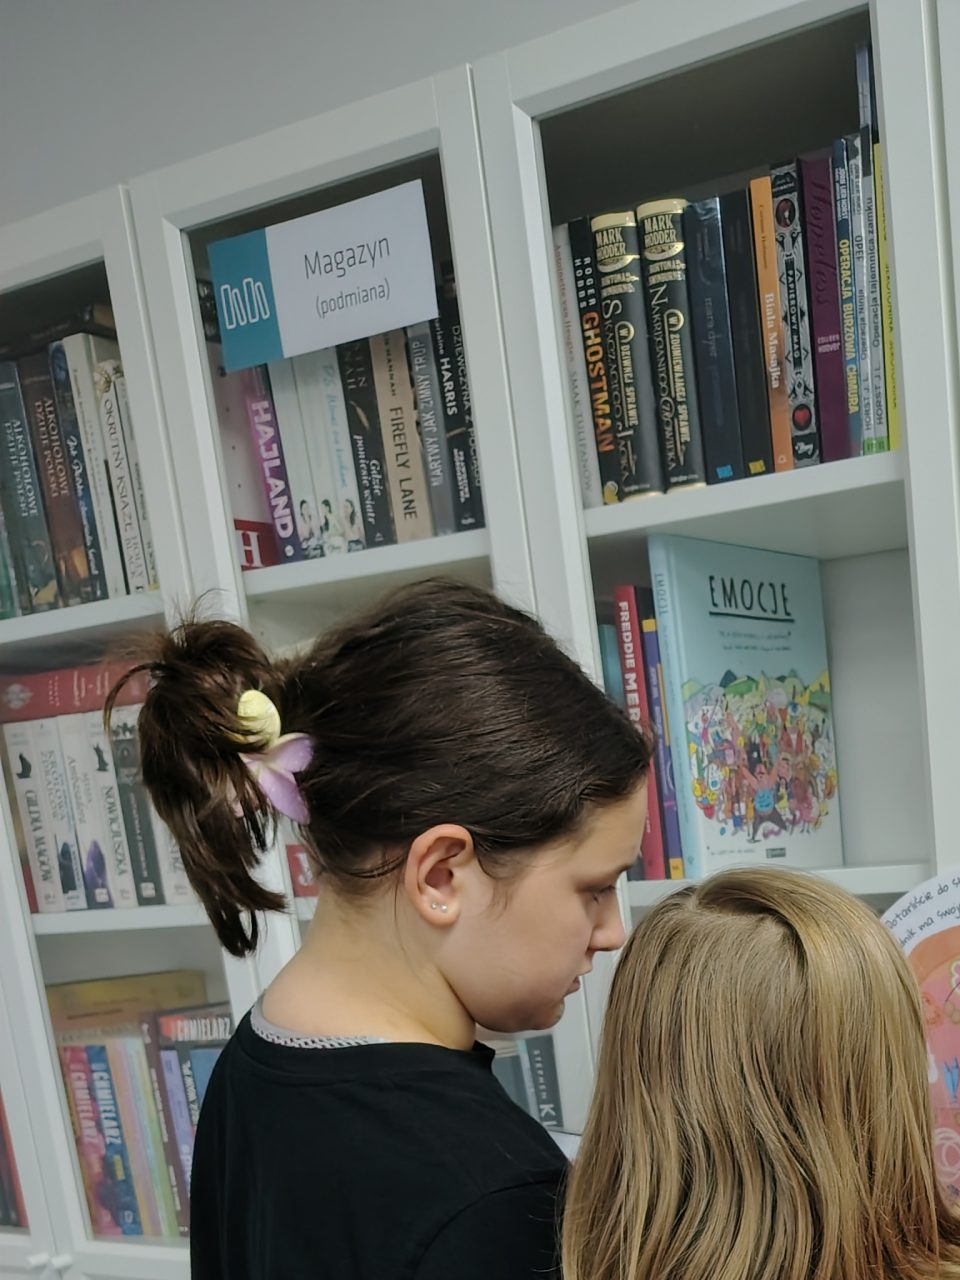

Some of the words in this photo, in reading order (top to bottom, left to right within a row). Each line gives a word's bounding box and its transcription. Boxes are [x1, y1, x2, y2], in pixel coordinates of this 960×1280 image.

[595, 227, 623, 248] MARK
[644, 214, 674, 233] MARK
[866, 196, 874, 236] zamku
[304, 237, 391, 279] Magazyn
[839, 239, 853, 299] OPERACJA
[868, 238, 878, 294] tajemnica
[315, 277, 391, 319] (podmiana)
[574, 258, 587, 309] HOBBS
[583, 257, 596, 306] ROGER
[858, 289, 866, 314] Ninja
[787, 270, 797, 329] PAPIEROWY
[792, 334, 802, 360] MAG
[843, 303, 857, 361] BURZOWA
[871, 297, 882, 348] Operacja
[411, 340, 428, 371] TRUP
[767, 331, 781, 389] Masajka
[859, 319, 868, 360] Operacja
[440, 356, 459, 417] HARRIS
[451, 324, 472, 412] DZIEWCZYNA
[582, 311, 616, 454] GHOSTMAN
[620, 343, 635, 387] DZIWNEJ
[416, 373, 434, 410] ZIMNY
[569, 370, 583, 408] SMAK
[625, 387, 639, 427] SPRAWIE
[847, 363, 860, 415] CHMURA
[876, 390, 885, 426] HORST
[104, 398, 123, 470] OKRUTNY
[389, 406, 412, 469] FIREFLY
[422, 411, 438, 435] JAK
[676, 402, 691, 443] SPRAWIE
[864, 399, 872, 431] HORST
[13, 419, 38, 517] ALKOHOLOWE
[43, 398, 69, 497] ALKOHOLOWE
[251, 400, 294, 540] HAJLAND
[426, 436, 444, 487] MARTWY
[353, 434, 371, 487] poniesie
[363, 487, 376, 525] wiatr
[369, 459, 383, 497] Gdzie
[399, 478, 418, 521] LANE
[708, 574, 793, 617] EMOCJE
[619, 601, 636, 669] FREDDIE
[25, 789, 39, 833] GILDIA
[103, 785, 126, 877] NOWICJUSZKA
[937, 884, 949, 895] do
[919, 916, 934, 932] ma
[175, 1016, 232, 1042] CHMIELARZ
[71, 1069, 100, 1145] CHMIELARZ
[93, 1070, 122, 1146] CHMIELARZ
